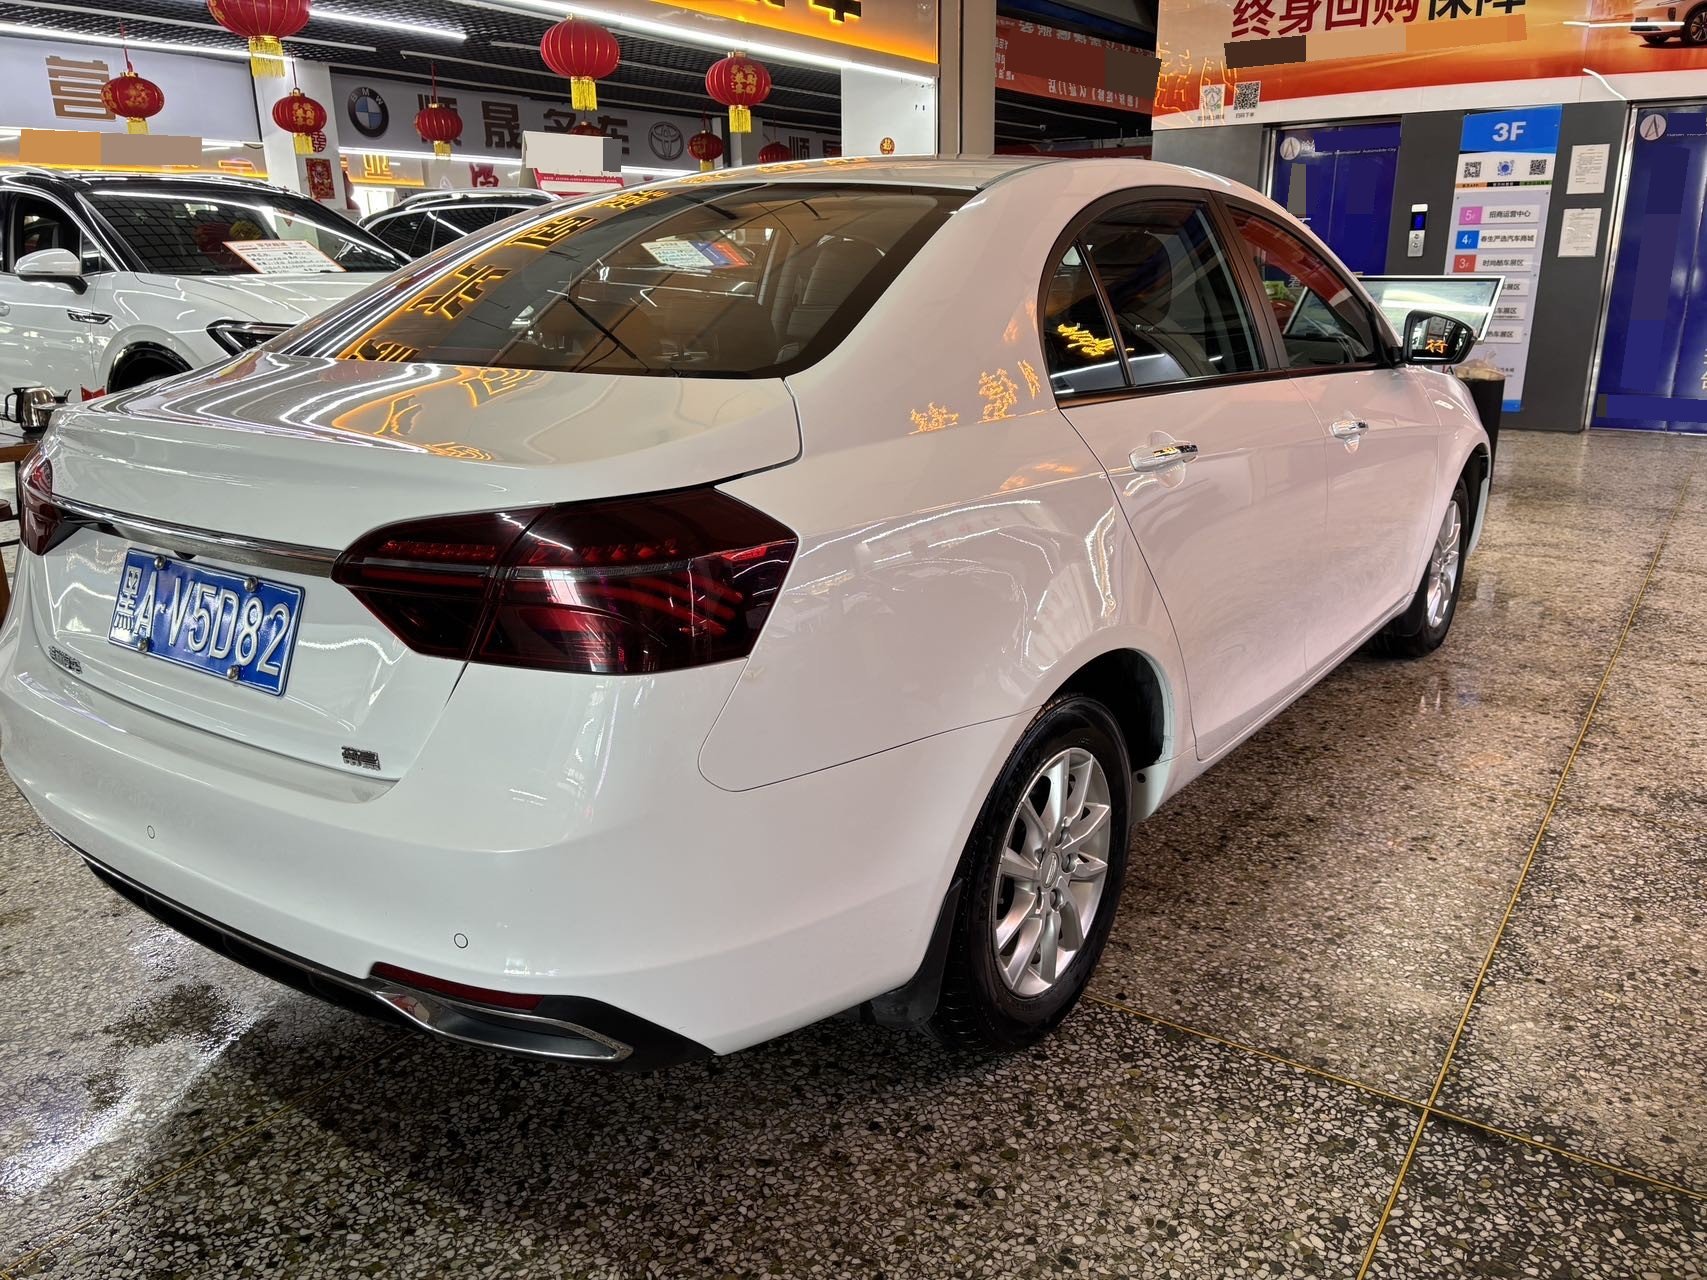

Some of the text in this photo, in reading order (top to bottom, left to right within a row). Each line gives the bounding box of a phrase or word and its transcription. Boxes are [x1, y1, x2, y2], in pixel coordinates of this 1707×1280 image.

[1492, 121, 1527, 142] 3F
[1489, 209, 1531, 219] 招商运营中心
